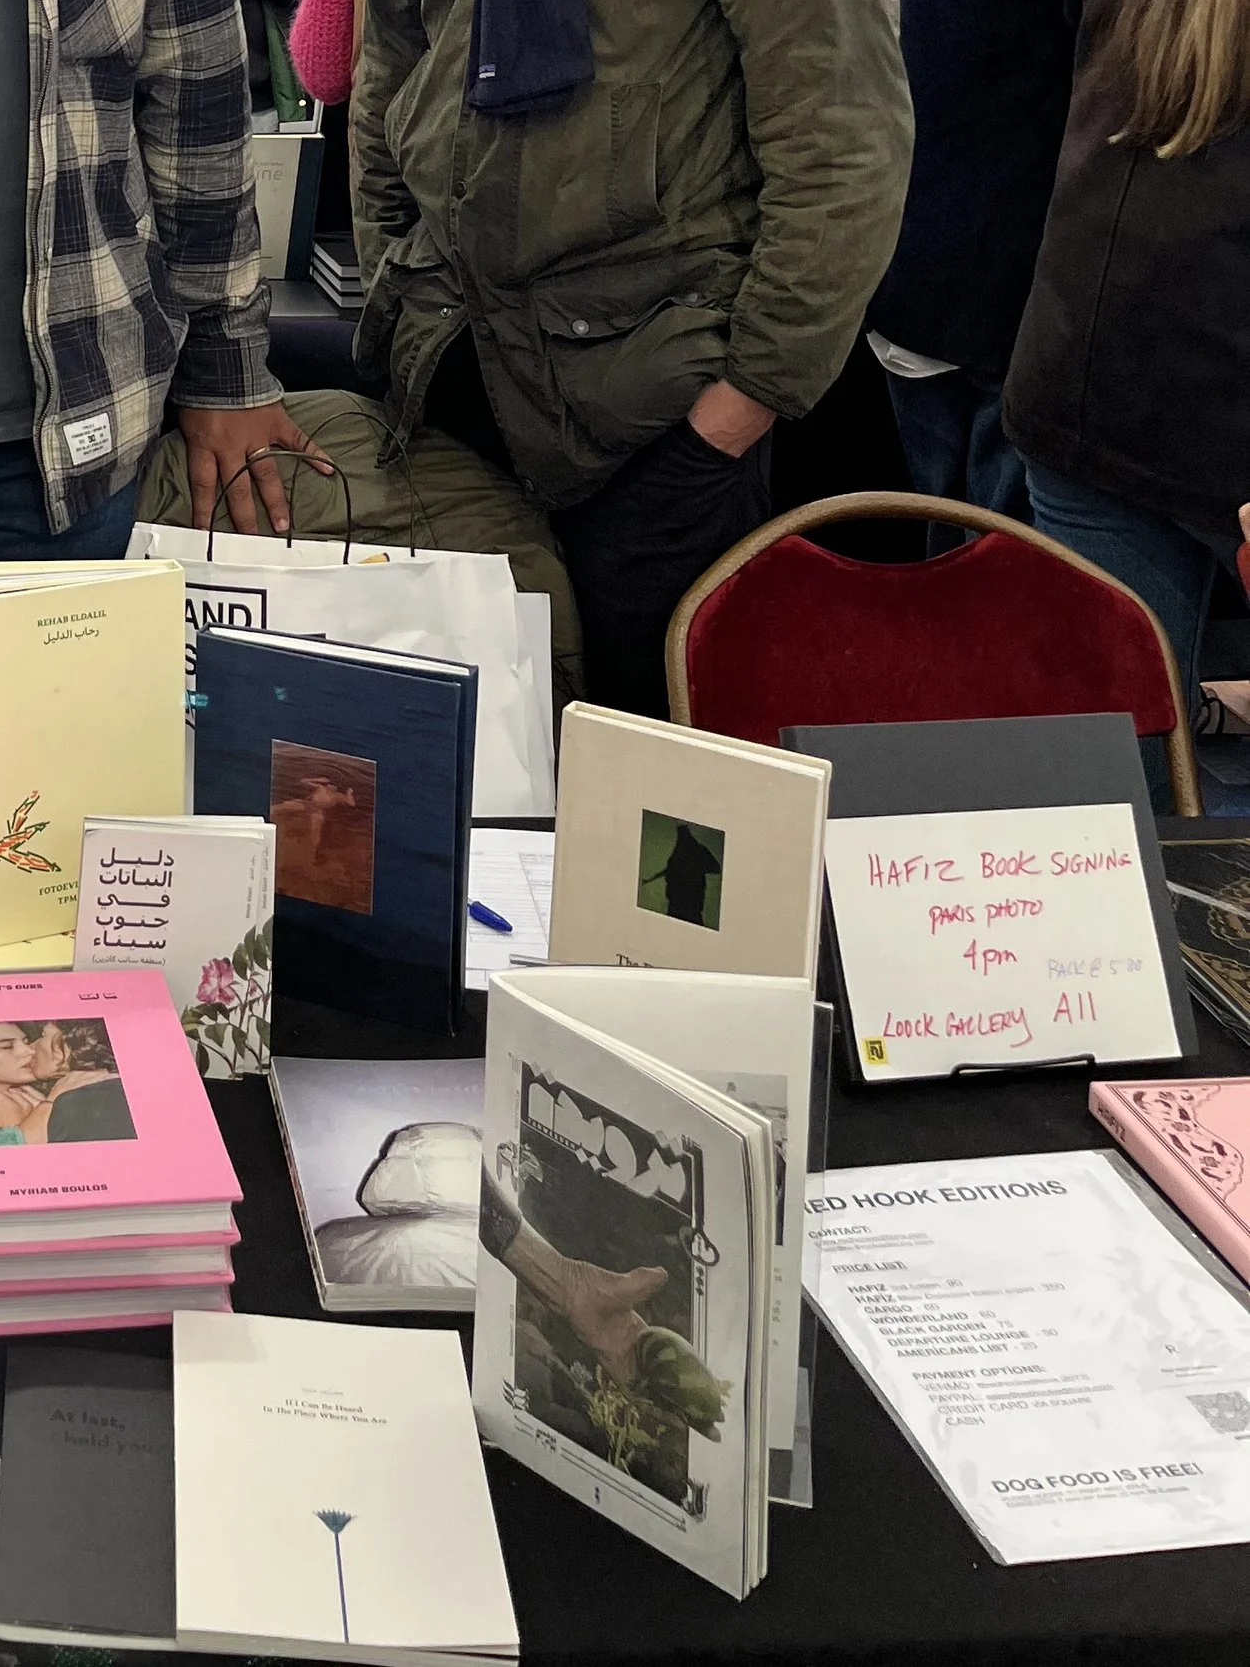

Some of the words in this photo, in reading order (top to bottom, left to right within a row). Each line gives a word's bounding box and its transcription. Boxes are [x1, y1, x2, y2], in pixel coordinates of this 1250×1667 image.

[37, 615, 69, 627] REHAB
[71, 609, 107, 622] ELDALIL
[44, 629, 73, 645] الدليل
[75, 627, 100, 640] رحاب
[100, 847, 174, 868] دليل
[99, 869, 173, 889] النباتات
[868, 853, 964, 887] HAFIZ
[97, 890, 170, 910] في
[96, 914, 169, 932] جنوب
[93, 931, 166, 950] سيناء
[963, 939, 1018, 975] 4pm
[10, 1186, 59, 1196] MYRIAM
[62, 1183, 108, 1193] BOULOS
[852, 1189, 938, 1209] HOOK
[939, 1180, 1068, 1203] EDITIONS
[870, 1310, 969, 1325] WONDERLAND
[971, 1330, 1030, 1343] LOUNGE
[896, 1343, 979, 1358] AMERICANS
[912, 1369, 977, 1381] PAYMENT
[989, 1400, 1029, 1412] CARD
[991, 1478, 1044, 1494] DOG
[1046, 1471, 1110, 1489] FOOD
[1113, 1469, 1136, 1482] IS
